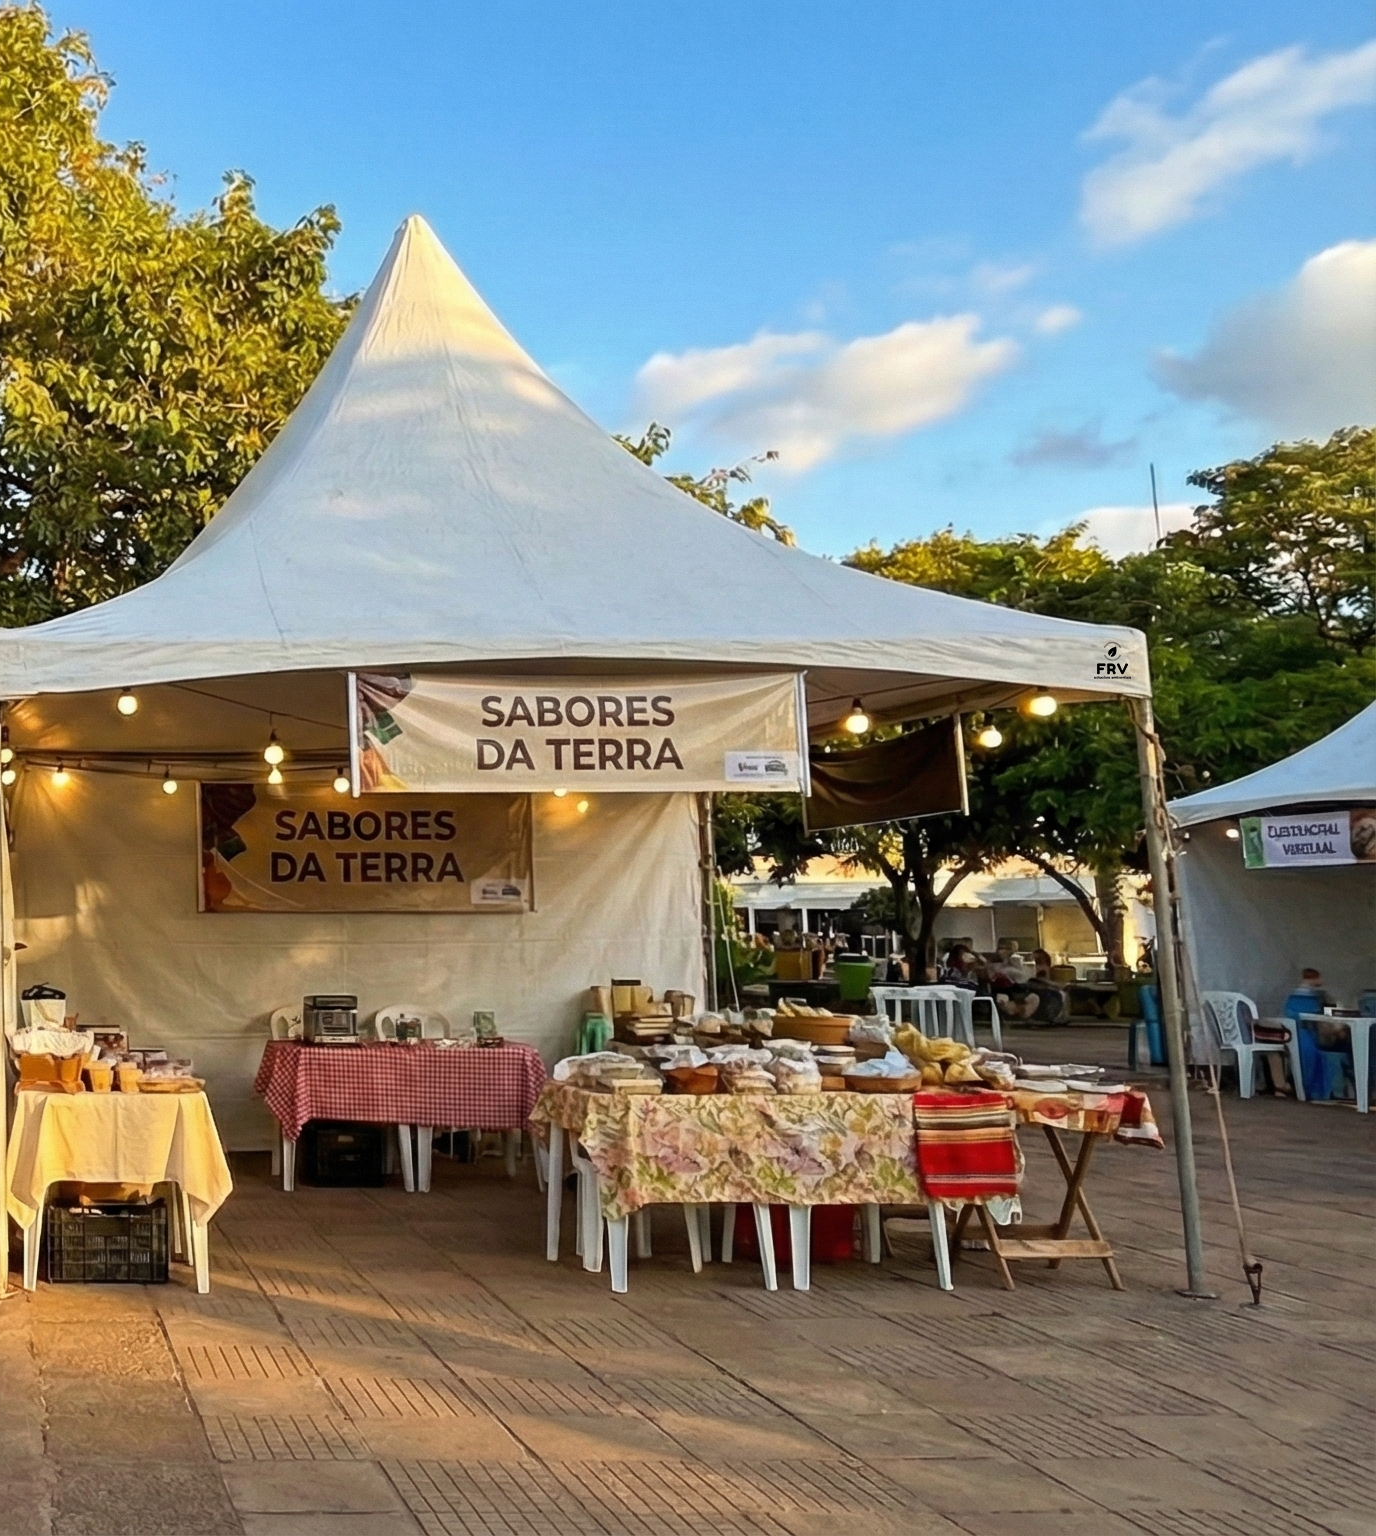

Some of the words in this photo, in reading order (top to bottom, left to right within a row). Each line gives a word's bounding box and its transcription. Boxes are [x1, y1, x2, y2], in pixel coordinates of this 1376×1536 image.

[1097, 663, 1128, 675] FRV
[481, 695, 675, 728] SABORES
[476, 738, 535, 771] DA
[545, 737, 684, 771] TERRA
[275, 810, 457, 841] SABORES
[270, 852, 326, 883] DA
[335, 852, 465, 883] TERRA
